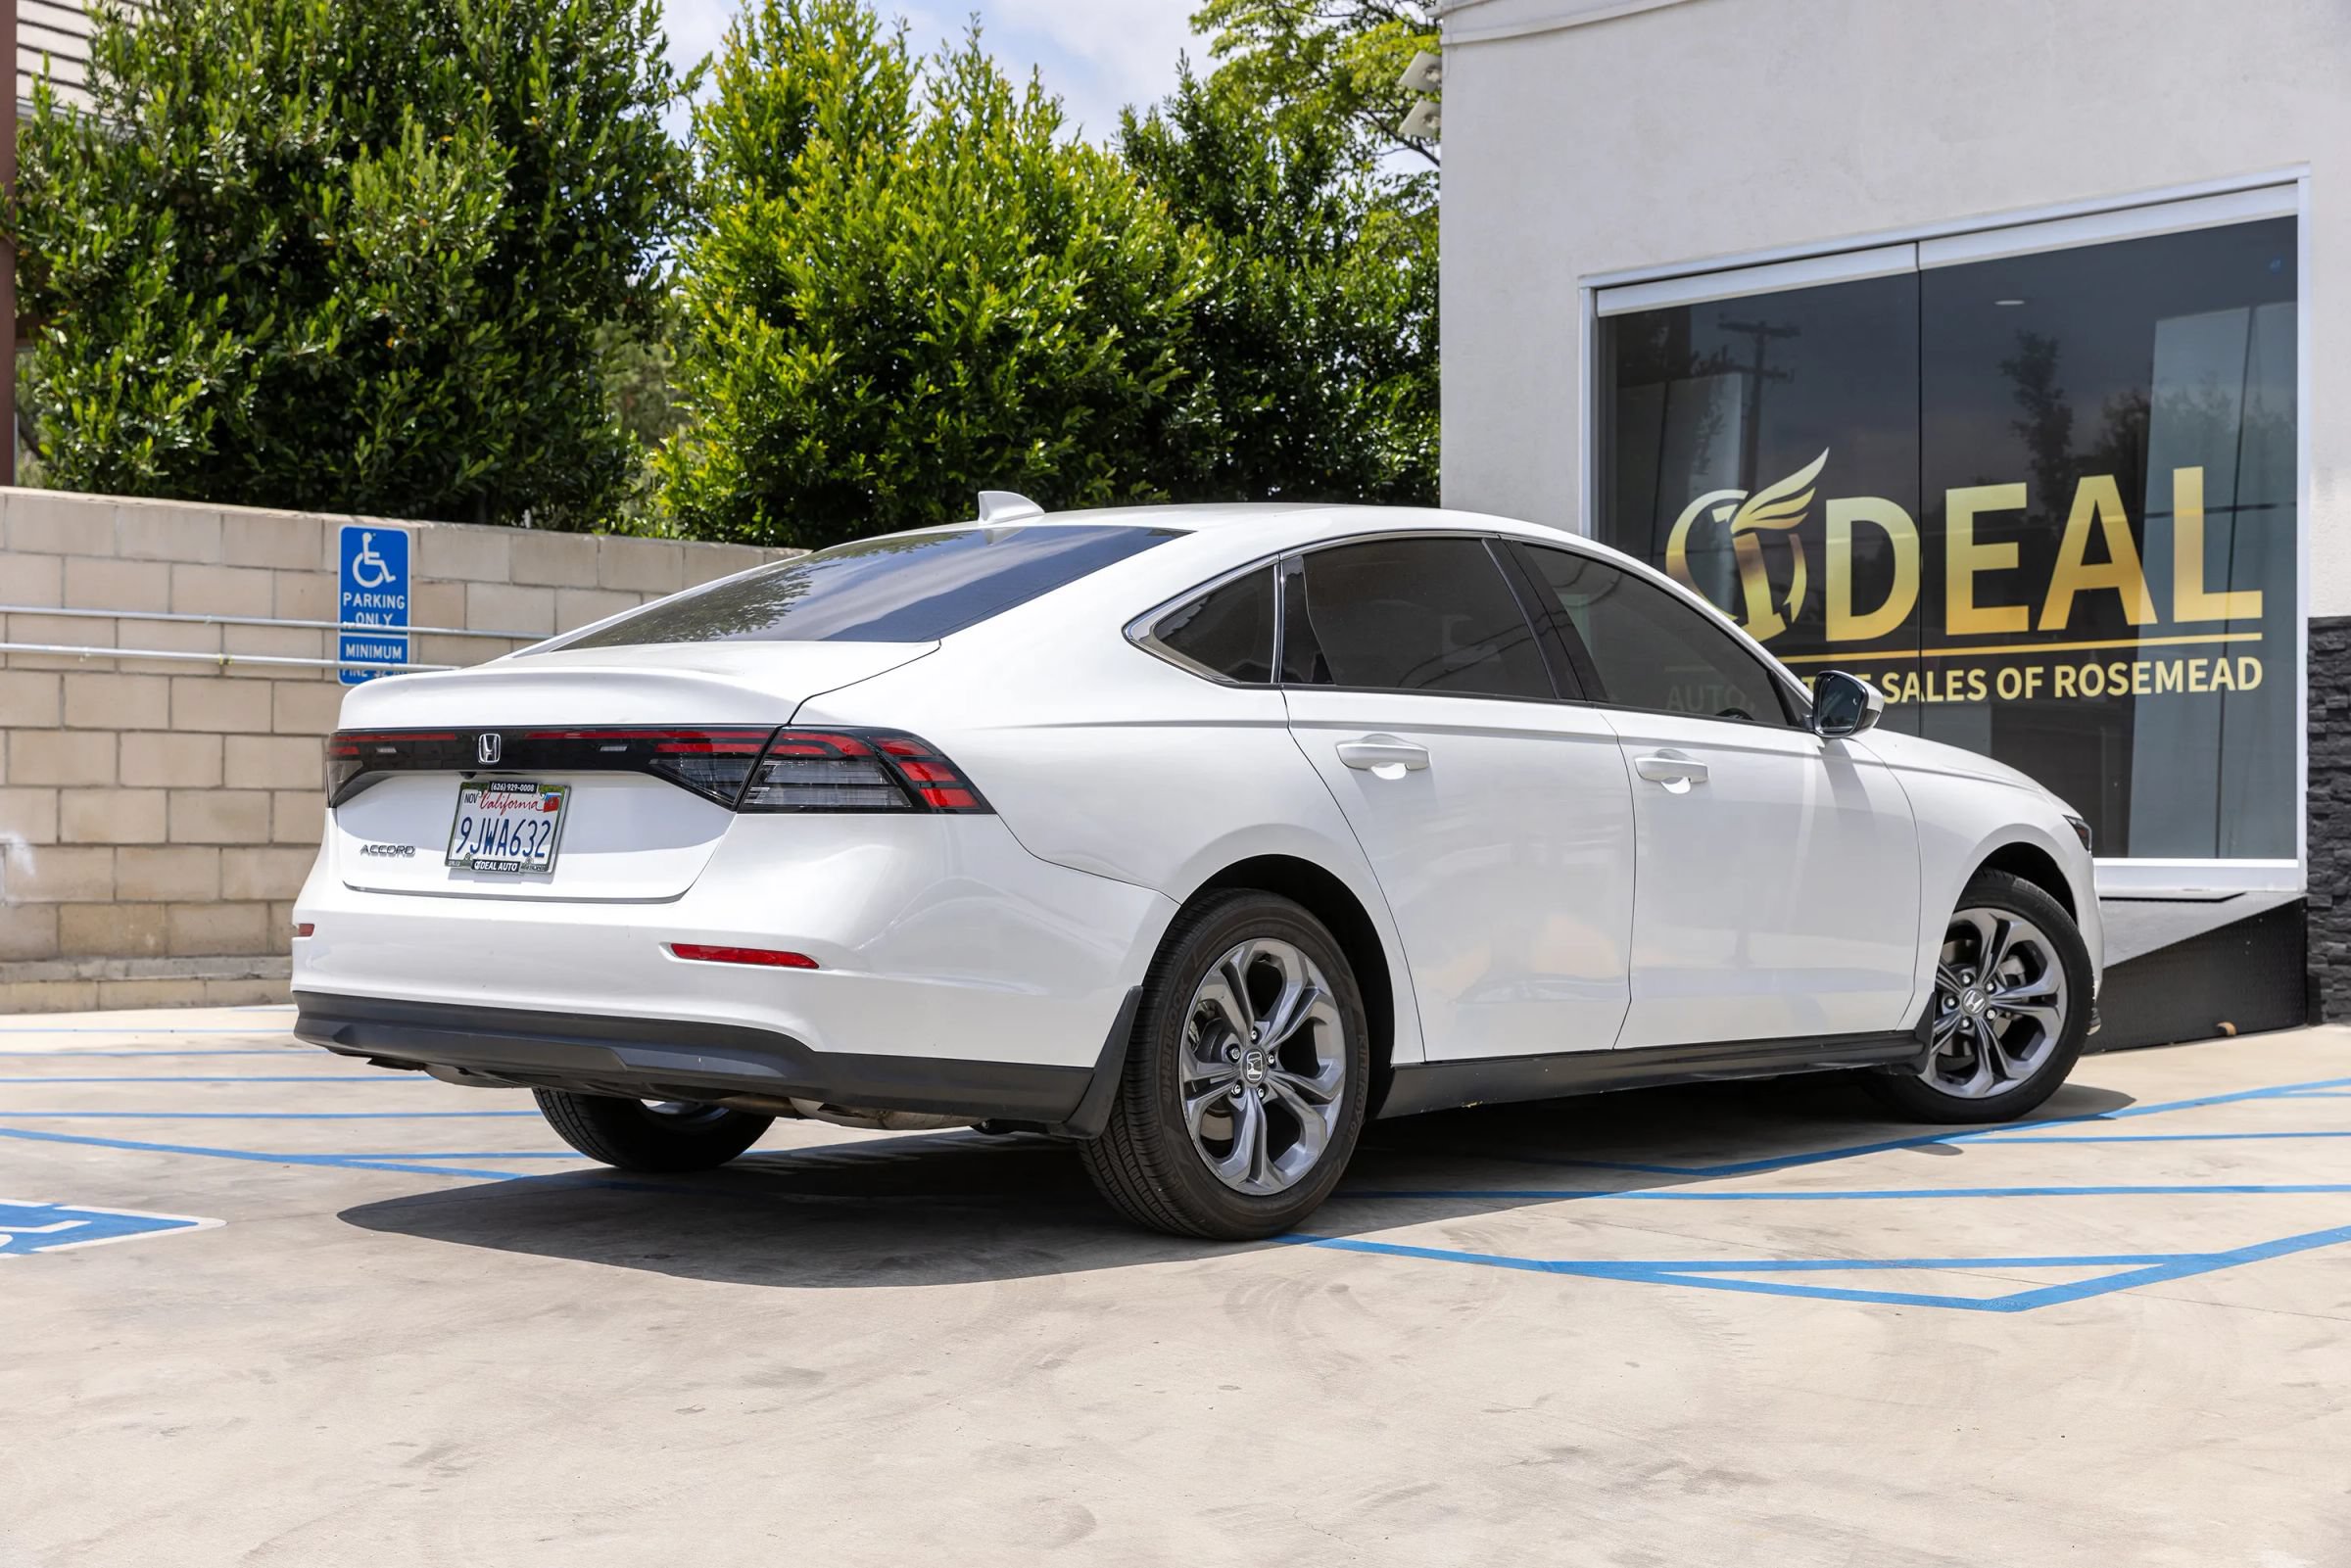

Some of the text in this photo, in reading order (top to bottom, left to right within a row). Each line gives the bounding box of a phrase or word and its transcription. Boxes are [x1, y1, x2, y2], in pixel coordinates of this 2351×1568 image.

[343, 592, 406, 610] PARKING
[355, 611, 394, 626] ONLY
[345, 643, 403, 660] MINIMUM
[1882, 668, 1989, 704] SALES
[1996, 665, 2044, 701] OF
[2054, 655, 2264, 698] ROSEMEAD
[491, 783, 506, 792] (626)
[463, 791, 479, 804] NOV
[479, 789, 545, 816] California
[456, 816, 552, 859] 9JWA632
[360, 844, 416, 857] ACCORD
[499, 862, 518, 872] AUTO
